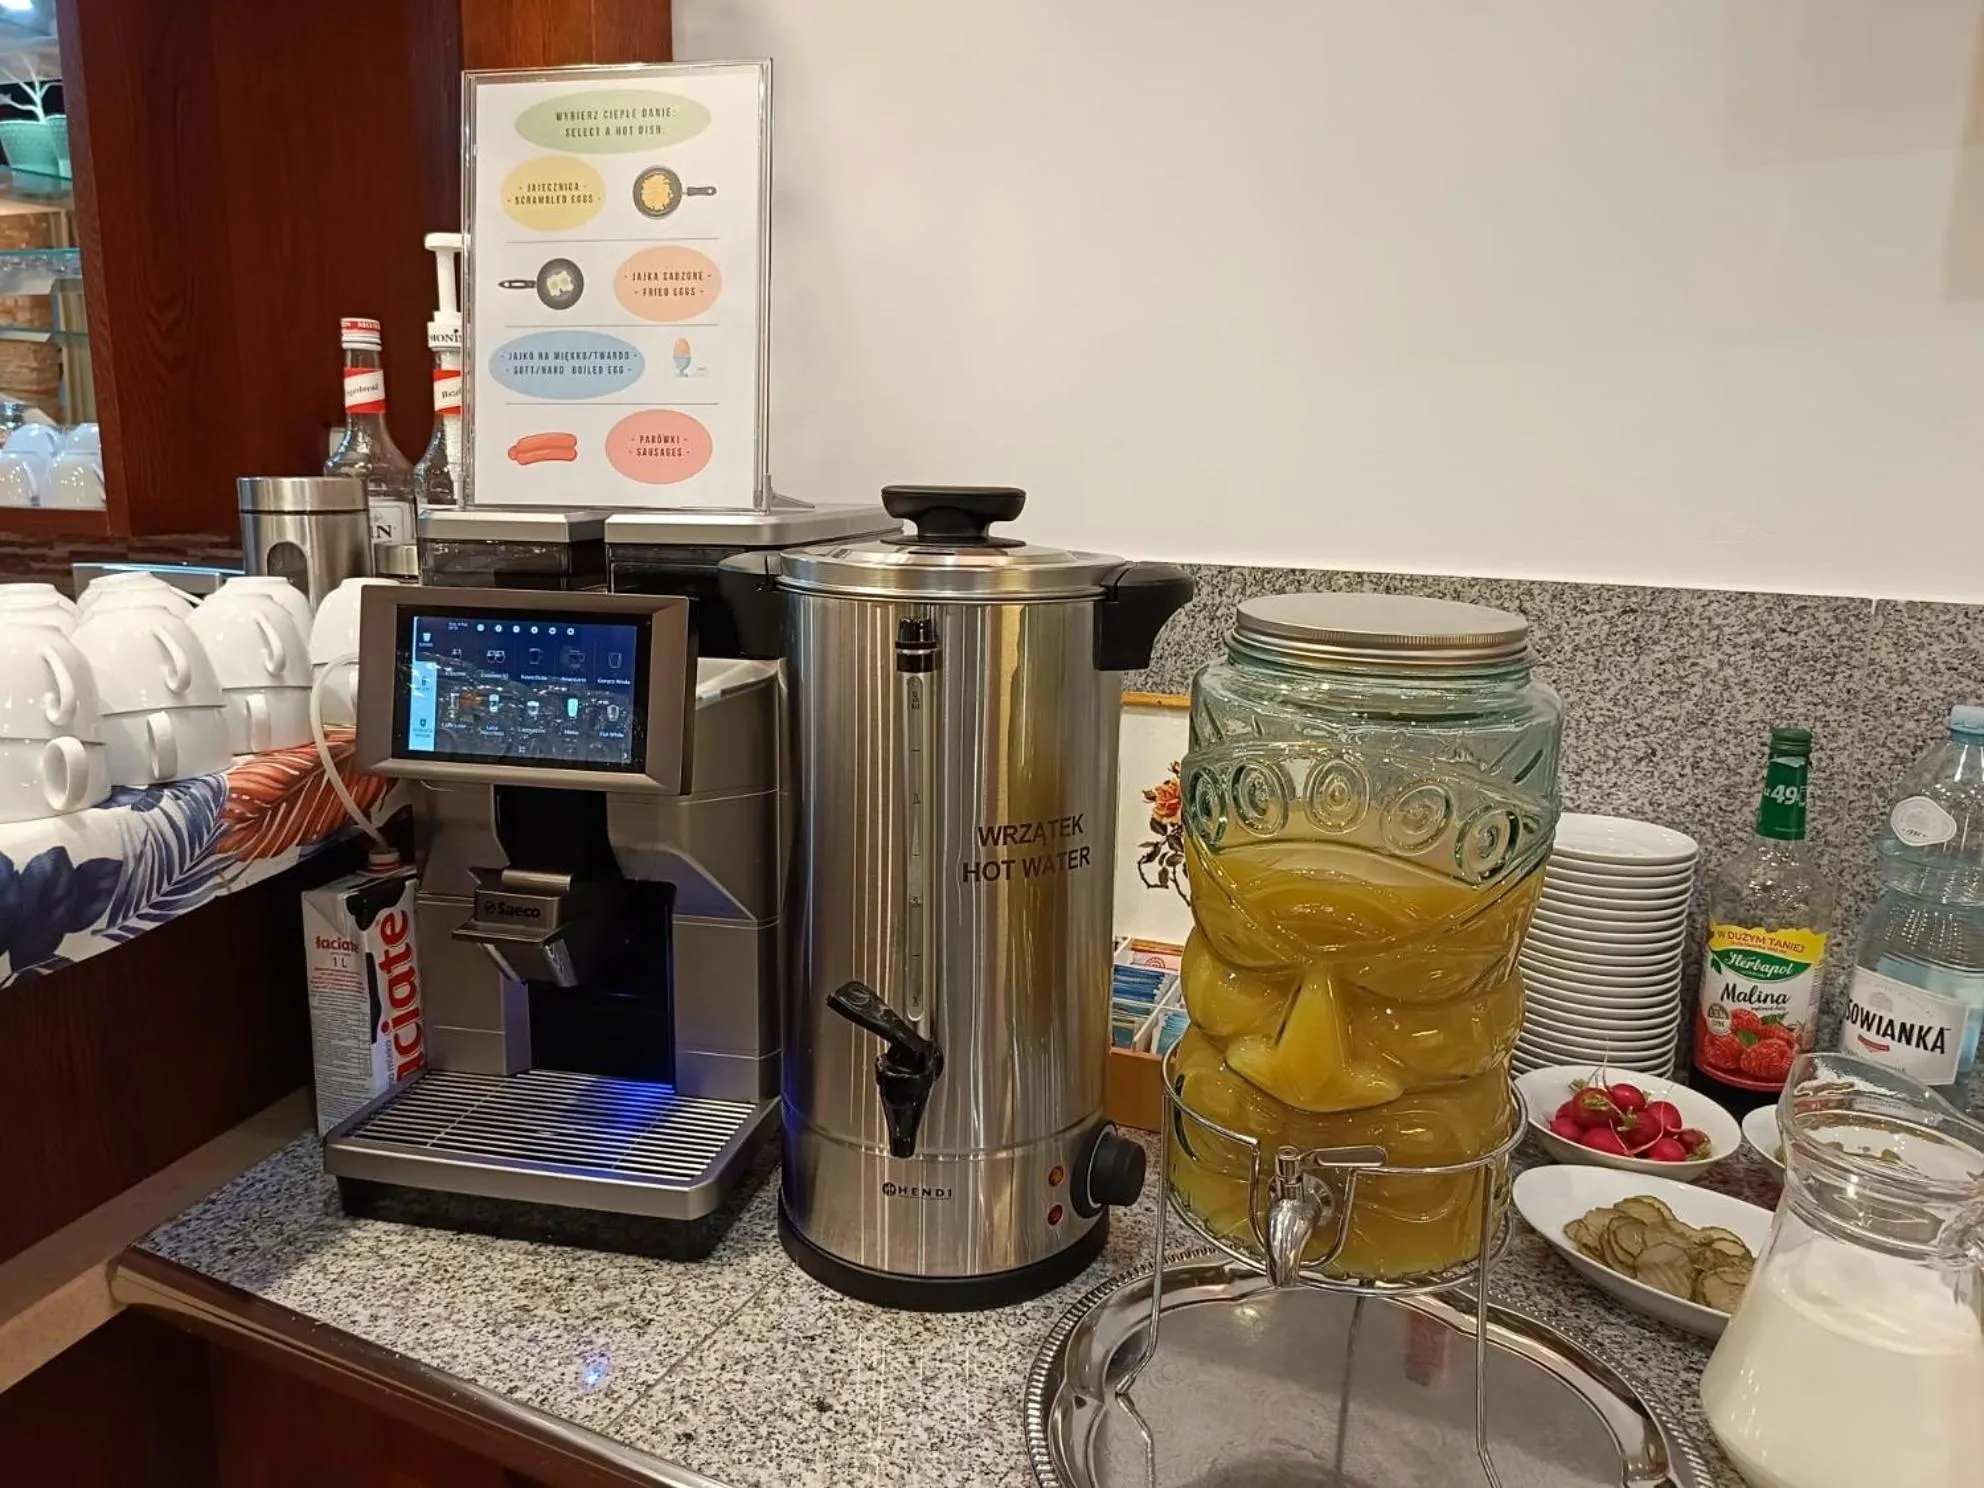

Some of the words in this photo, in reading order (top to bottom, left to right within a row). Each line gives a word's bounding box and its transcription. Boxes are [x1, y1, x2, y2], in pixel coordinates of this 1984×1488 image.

[556, 110, 599, 121] WYBIERZ
[565, 127, 600, 138] SELECT
[605, 126, 611, 137] A
[615, 126, 633, 136] HOT
[527, 182, 579, 193] JAJECZNICA
[514, 195, 567, 205] SCRAMBLED
[571, 194, 593, 204] EGGS
[632, 271, 658, 281] JAJKA
[662, 271, 703, 281] SADZONE
[642, 287, 669, 297] FRIED
[673, 287, 696, 297] EGGS
[508, 351, 534, 361] JAJKO
[538, 351, 550, 361] NA
[553, 351, 630, 362] MIĘKKO/TWARDO
[513, 365, 565, 375] SOFT/HARD
[607, 365, 624, 375] EGG
[639, 432, 680, 444] PARÓWKI
[636, 447, 682, 457] SAUSAGES
[977, 813, 1085, 848] WRZĄTEK
[962, 860, 1016, 883] HOT
[1022, 846, 1091, 879] WATER
[498, 901, 541, 918] Saeco
[1717, 931, 1726, 939] W
[1768, 937, 1805, 953] TANIEJ
[1724, 951, 1793, 978] Herbapol
[1720, 982, 1790, 1006] Malina
[898, 1185, 952, 1197] HENDI
